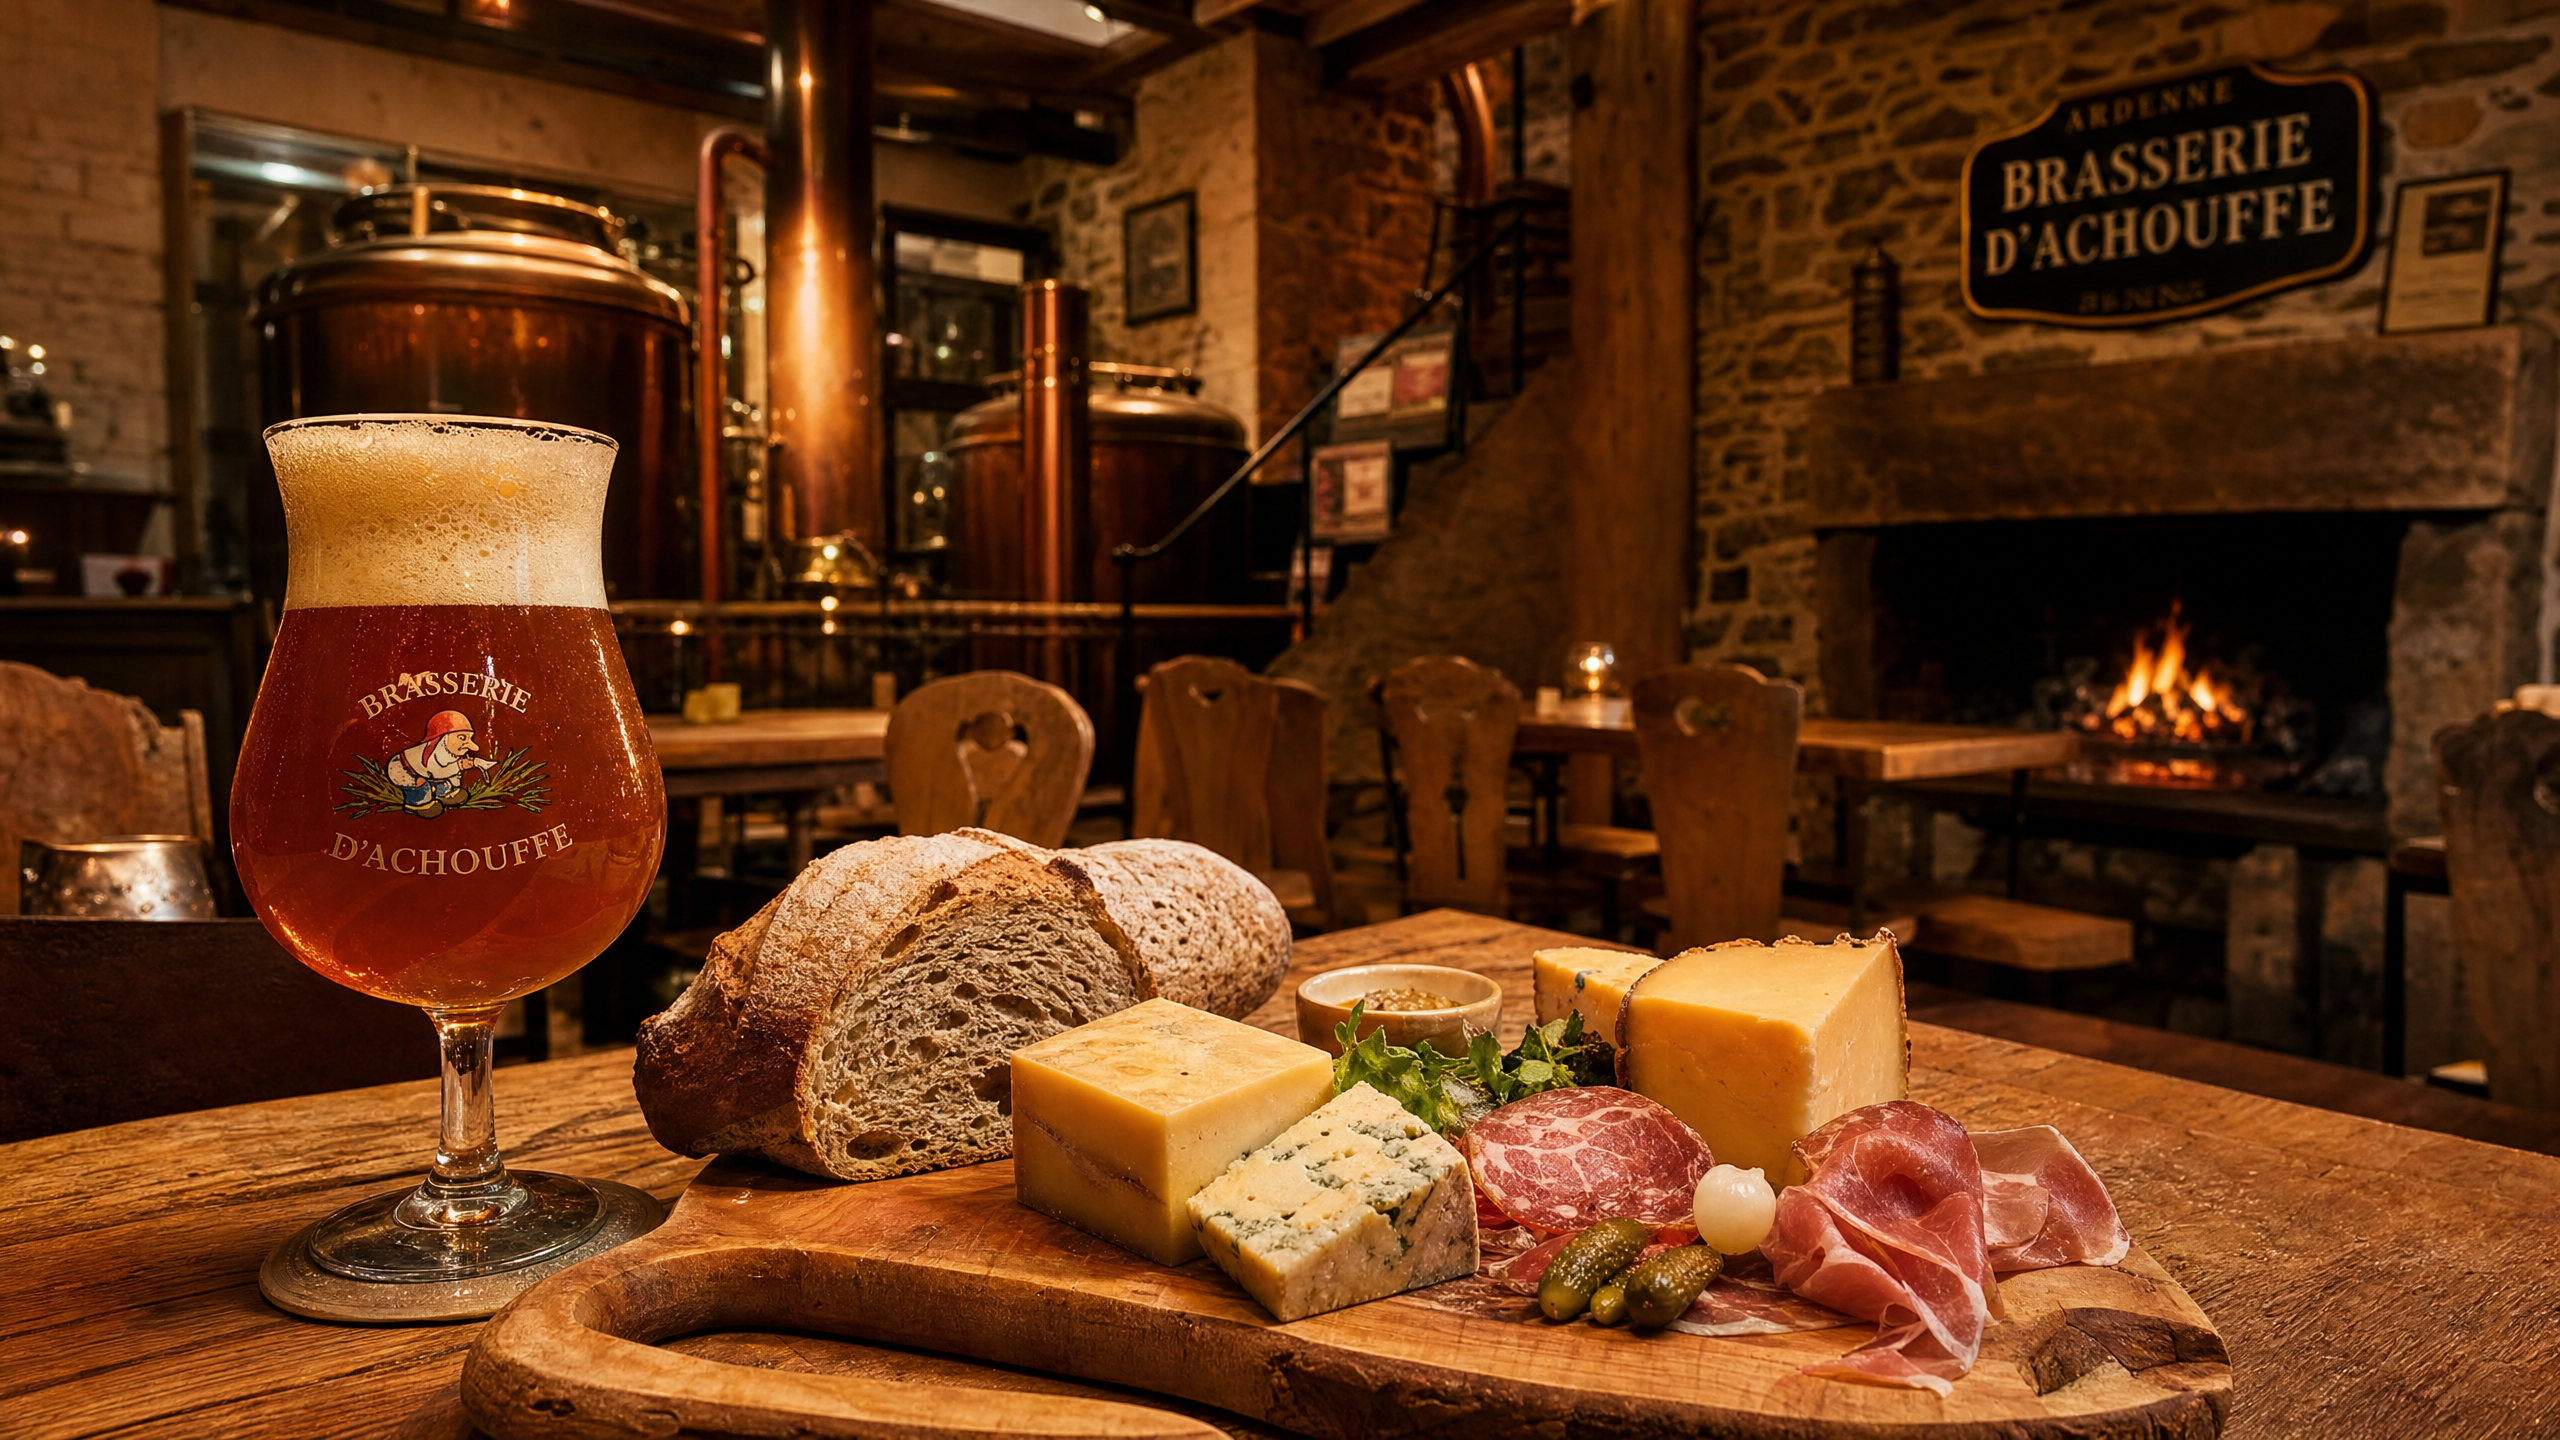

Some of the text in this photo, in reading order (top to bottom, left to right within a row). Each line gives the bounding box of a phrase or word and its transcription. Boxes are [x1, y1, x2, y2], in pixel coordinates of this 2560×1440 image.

[2064, 76, 2235, 134] ARDENNE
[2001, 112, 2313, 213] BRASSERIE
[1983, 178, 2336, 277] D'ACHOUFFE
[358, 671, 532, 719] BRASSERIE
[328, 823, 574, 876] D'ACHOUFFE
